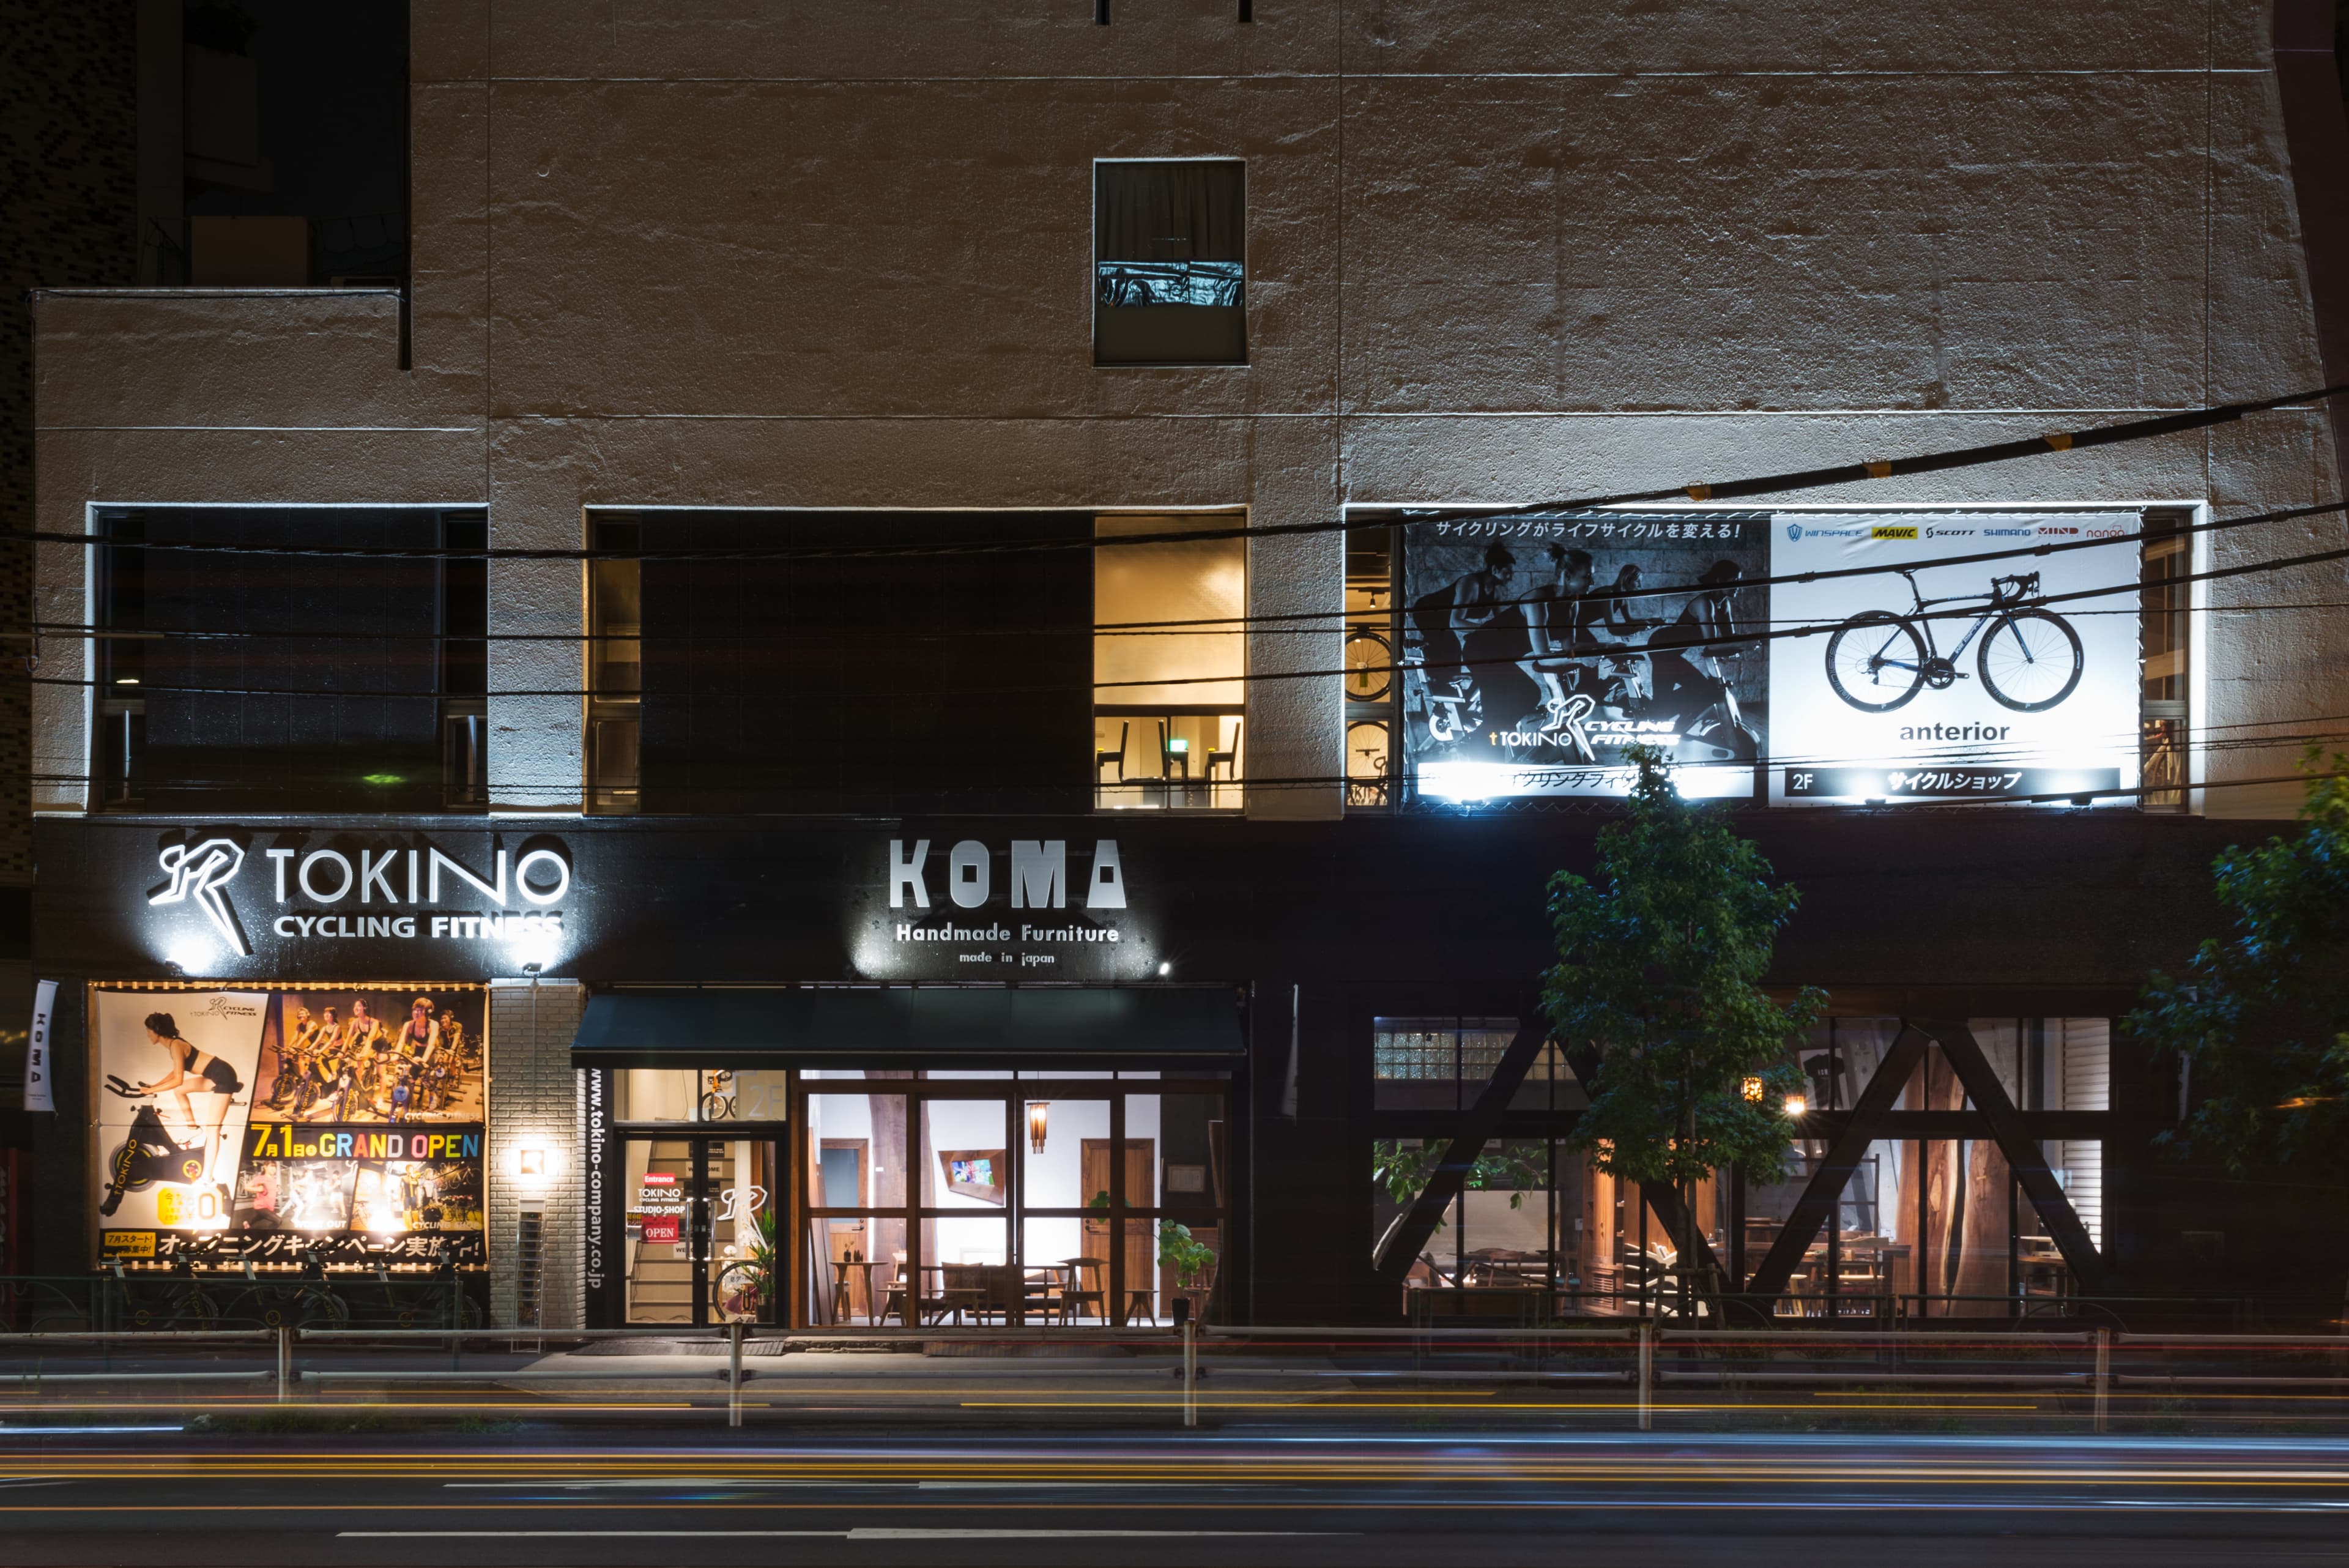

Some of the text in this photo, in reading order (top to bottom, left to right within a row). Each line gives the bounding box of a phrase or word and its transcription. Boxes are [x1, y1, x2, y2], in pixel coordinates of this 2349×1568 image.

[1874, 529, 1915, 537] MAVIC
[1584, 721, 1675, 732] CYCLING
[1899, 722, 2010, 741] anterior
[1500, 732, 1572, 746] TOKINO
[1590, 734, 1681, 745] FITNESS
[1793, 772, 2022, 790] 2F サイクルショップ
[266, 848, 570, 905] TOKINO
[889, 839, 1127, 908] KOMA
[273, 916, 562, 939] CYCLING FITNESS
[896, 922, 1119, 942] Handmade Furniture
[959, 951, 1055, 967] made in japan
[31, 1013, 46, 1083] KOMA
[748, 1085, 783, 1117] 2F
[404, 1112, 443, 1121] CYCLING
[319, 1134, 403, 1158] GRAND
[411, 1134, 478, 1158] OPEN
[588, 1068, 605, 1288] www.tokino-company.co.jp
[638, 1188, 681, 1197] TOKINO
[633, 1205, 686, 1214] STUDIO-SHOP
[327, 1220, 346, 1228] OUT
[412, 1221, 451, 1229] CYCLING
[646, 1228, 674, 1238] OPEN
